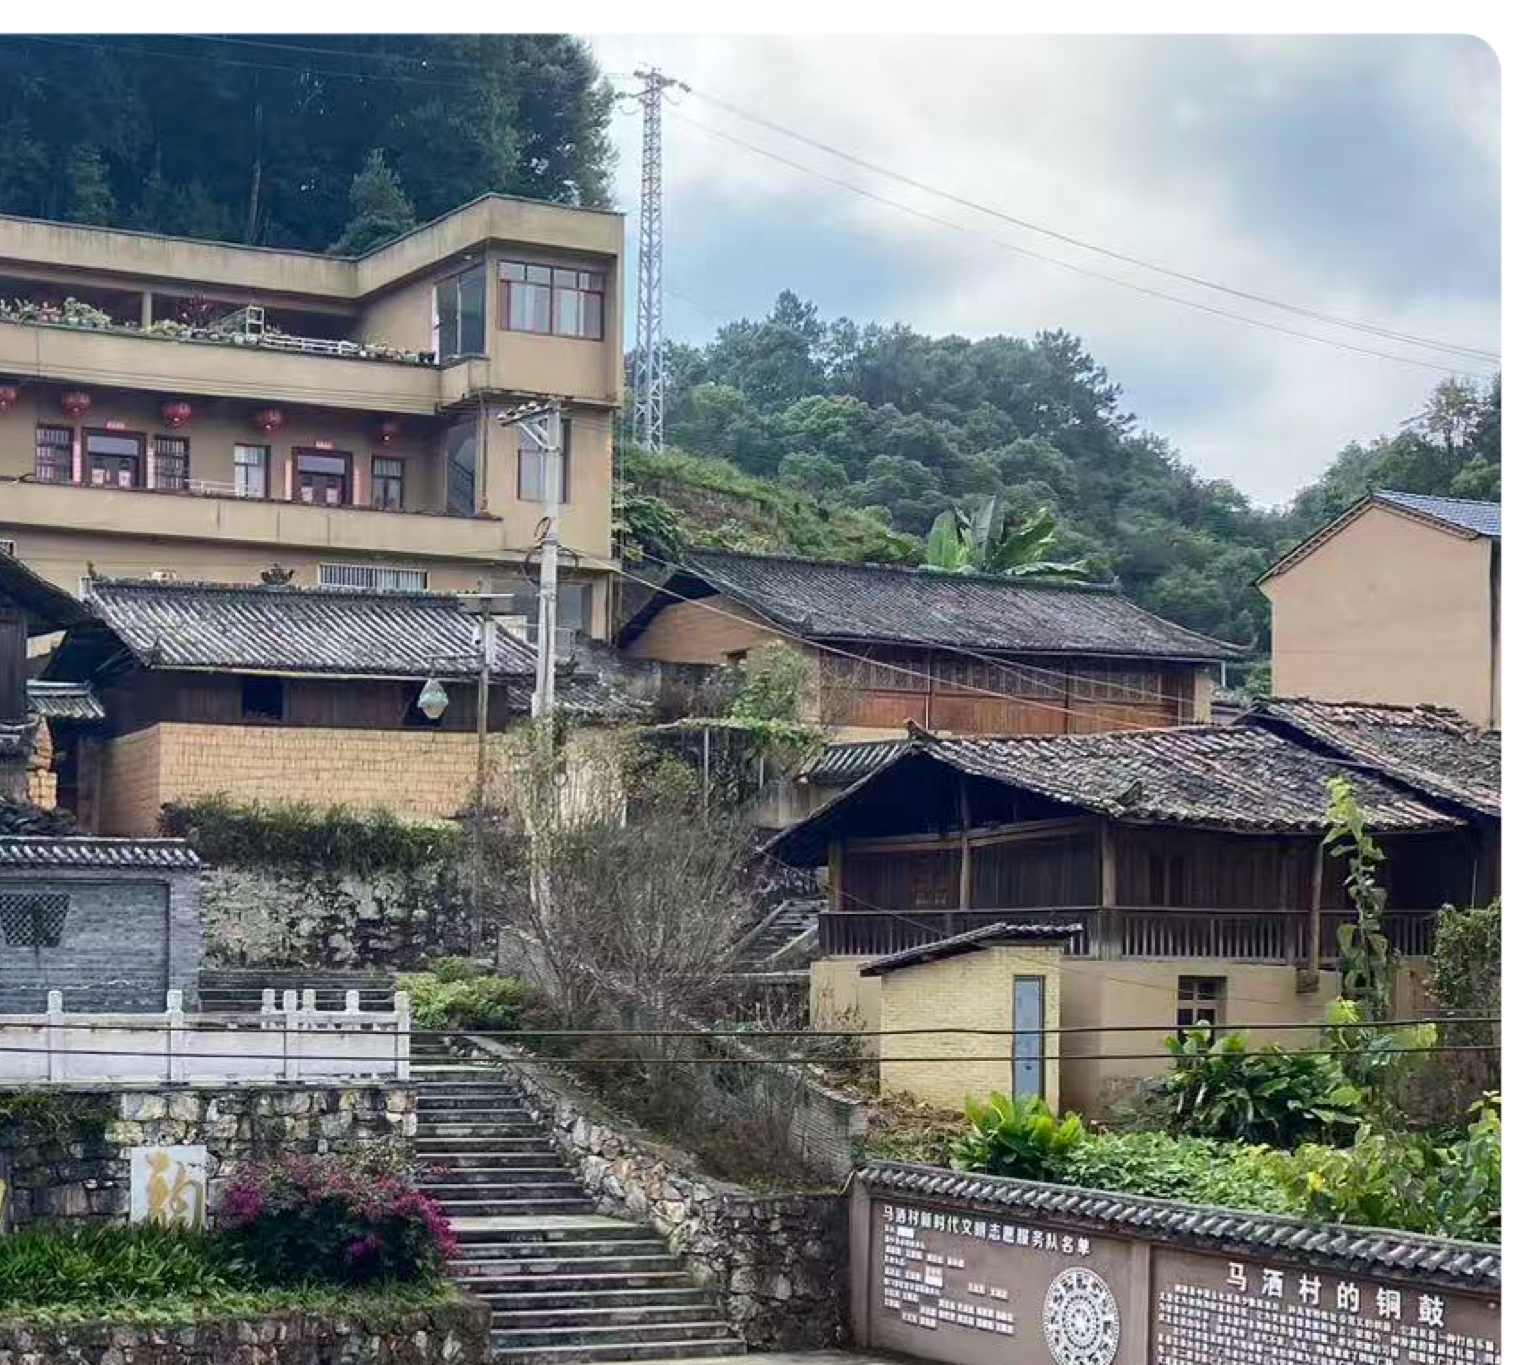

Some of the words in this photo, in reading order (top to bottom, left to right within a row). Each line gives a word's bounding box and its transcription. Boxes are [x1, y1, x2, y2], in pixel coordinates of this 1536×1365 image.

[1226, 1262, 1445, 1328] 马洒村的铜鼓
